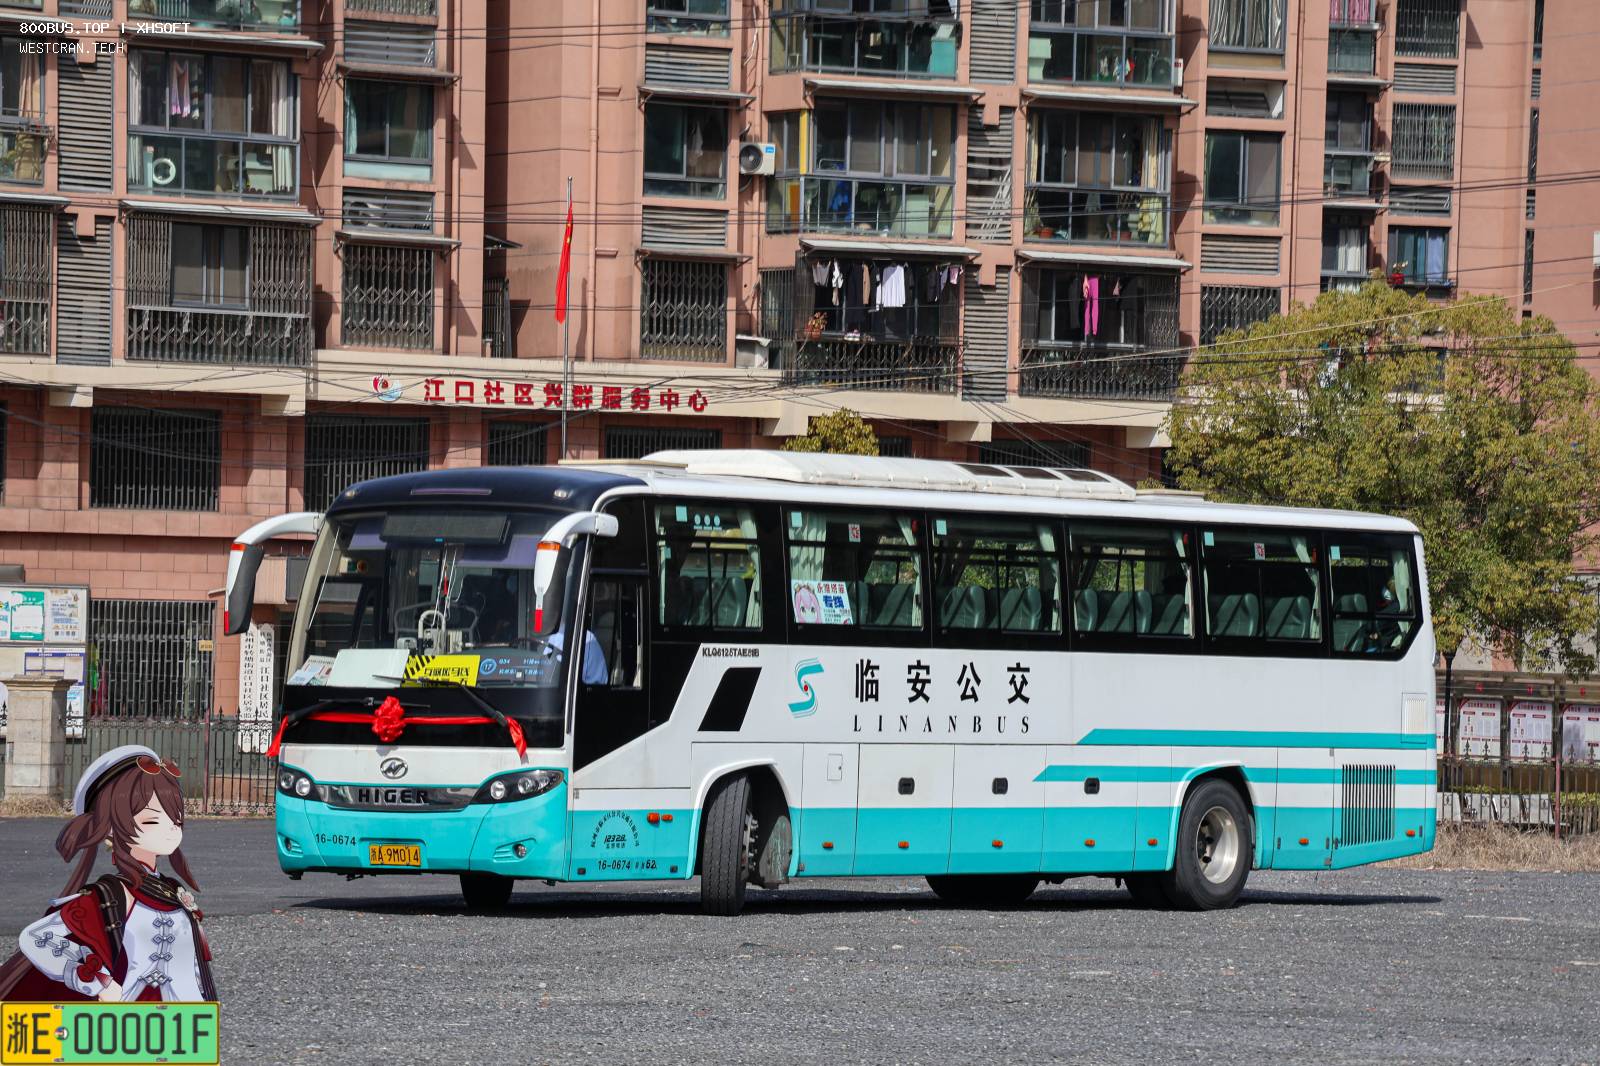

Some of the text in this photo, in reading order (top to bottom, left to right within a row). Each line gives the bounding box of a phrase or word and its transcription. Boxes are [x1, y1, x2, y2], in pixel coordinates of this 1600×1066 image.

[423, 377, 709, 413] 江口社区党群服务中心
[855, 658, 1032, 704] 临安公交
[358, 788, 428, 804] HIGER
[315, 833, 357, 846] 16-0674
[604, 834, 627, 844] 12328
[598, 860, 631, 871] 16-0674
